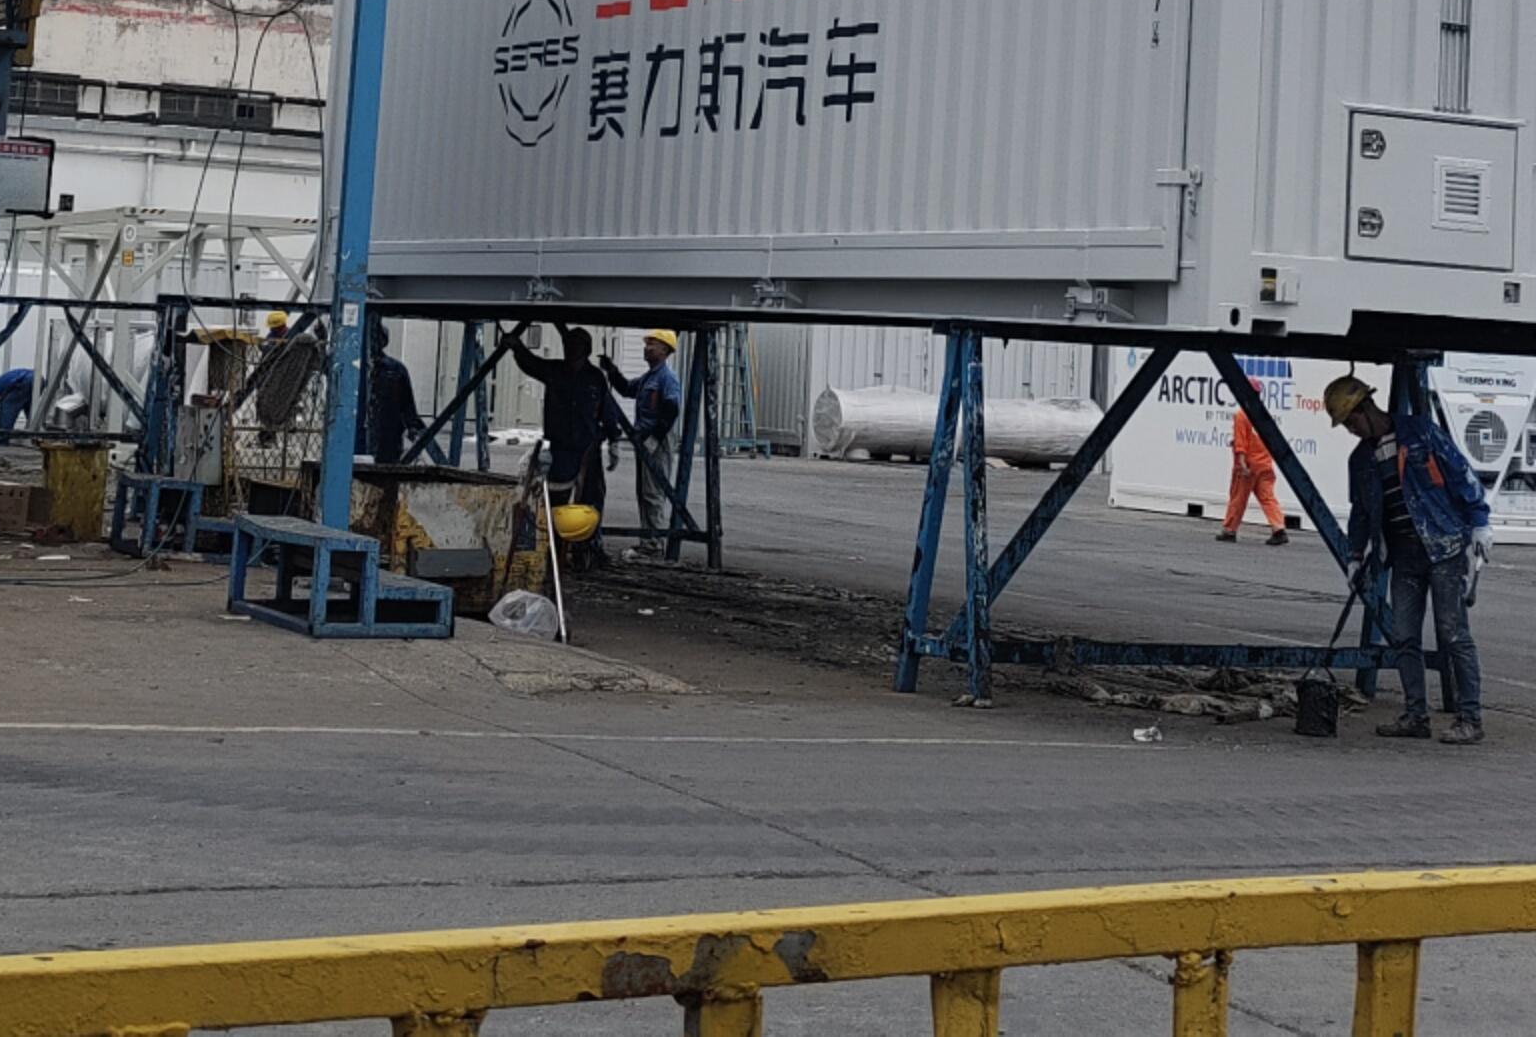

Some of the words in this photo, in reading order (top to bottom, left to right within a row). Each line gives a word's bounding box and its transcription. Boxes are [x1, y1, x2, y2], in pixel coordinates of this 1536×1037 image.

[494, 34, 581, 76] SERES
[587, 18, 880, 142] 赛力斯汽车
[1157, 374, 1293, 411] ARCTICRE
[1495, 378, 1517, 388] KING
